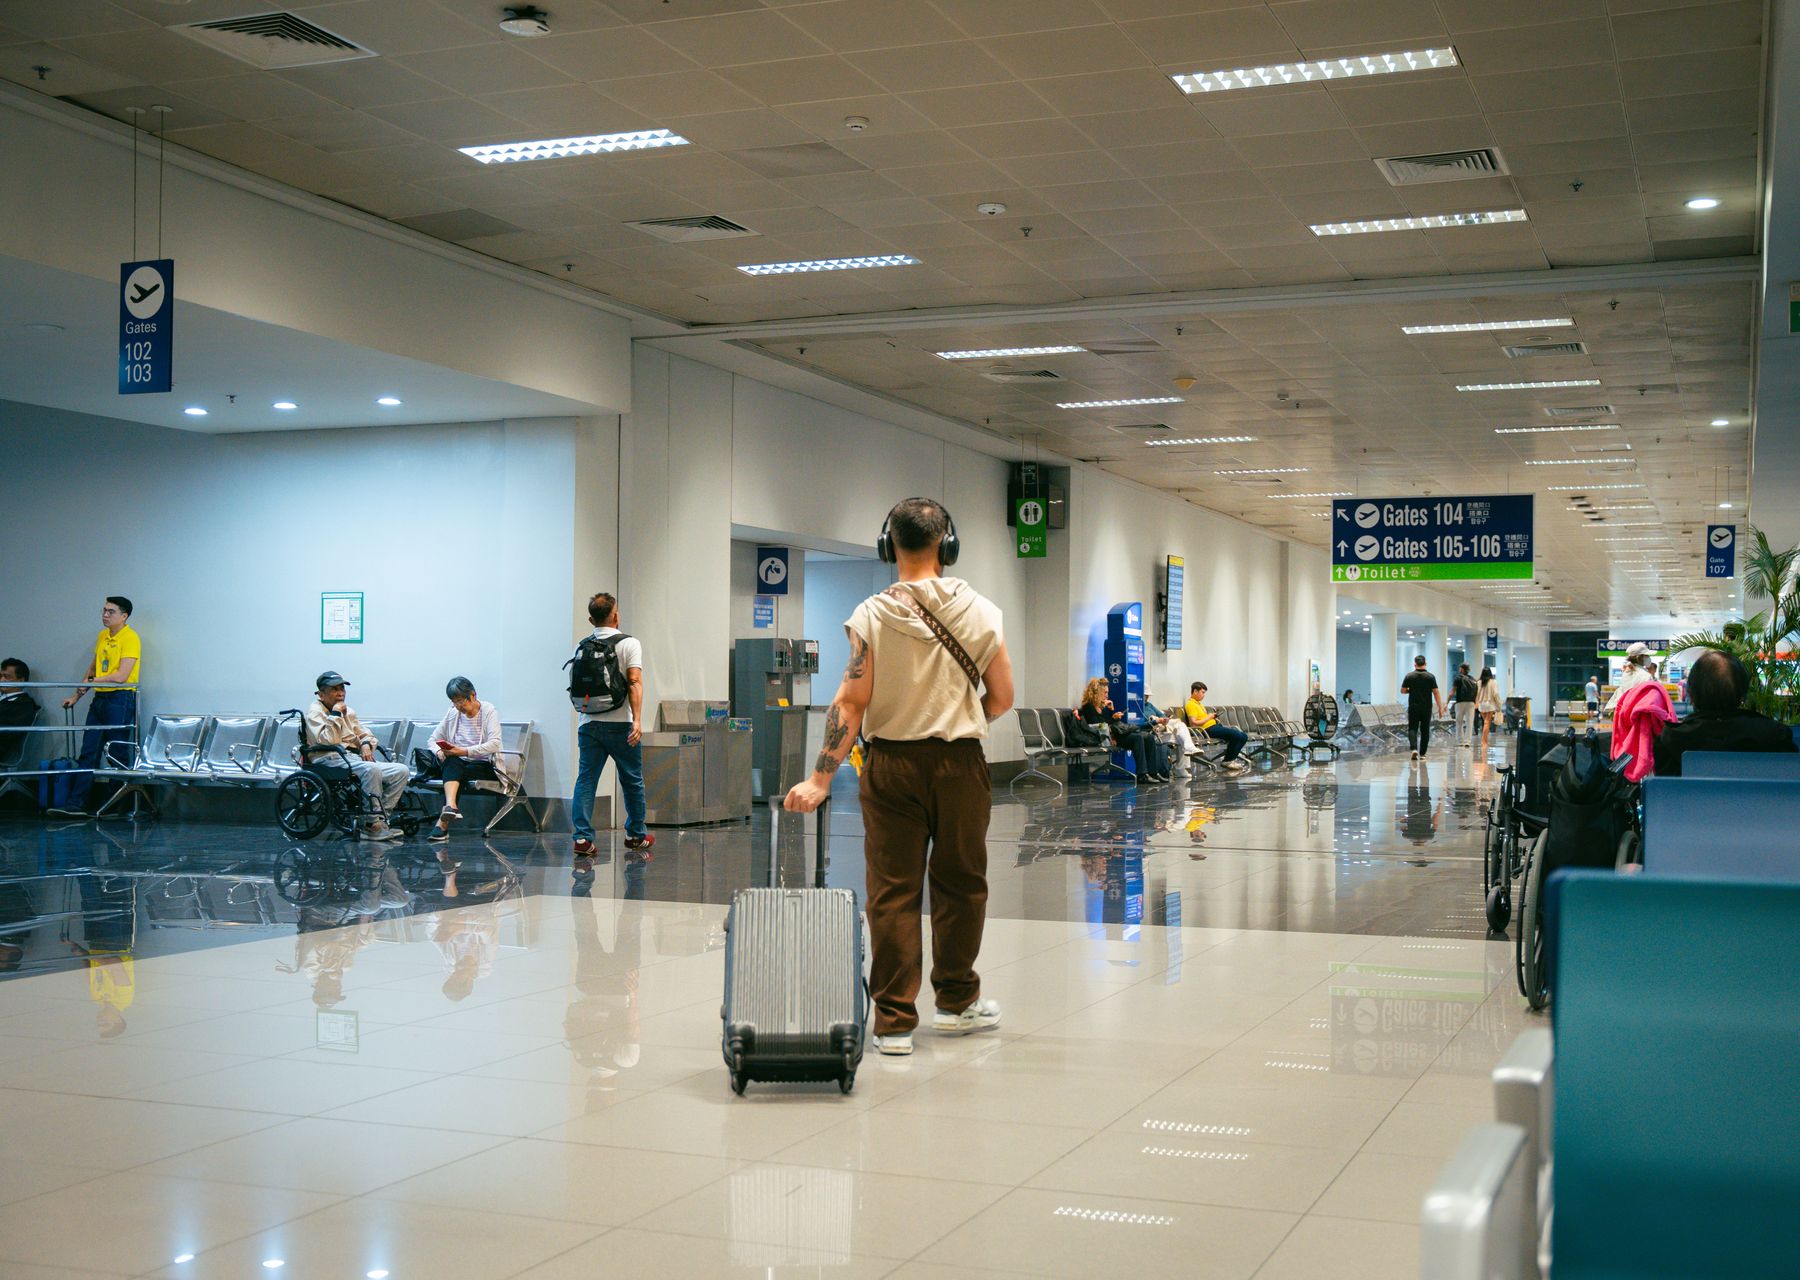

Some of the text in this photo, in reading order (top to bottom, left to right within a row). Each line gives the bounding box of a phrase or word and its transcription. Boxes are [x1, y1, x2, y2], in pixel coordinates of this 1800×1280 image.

[125, 321, 157, 334] Gates
[125, 341, 152, 361] 102
[125, 363, 152, 383] 103
[1383, 502, 1464, 527] Gates 104
[1021, 535, 1042, 543] Toilet
[1383, 534, 1501, 559] Gates 105-106
[1362, 566, 1406, 579] Toilet
[1709, 565, 1726, 574] 107
